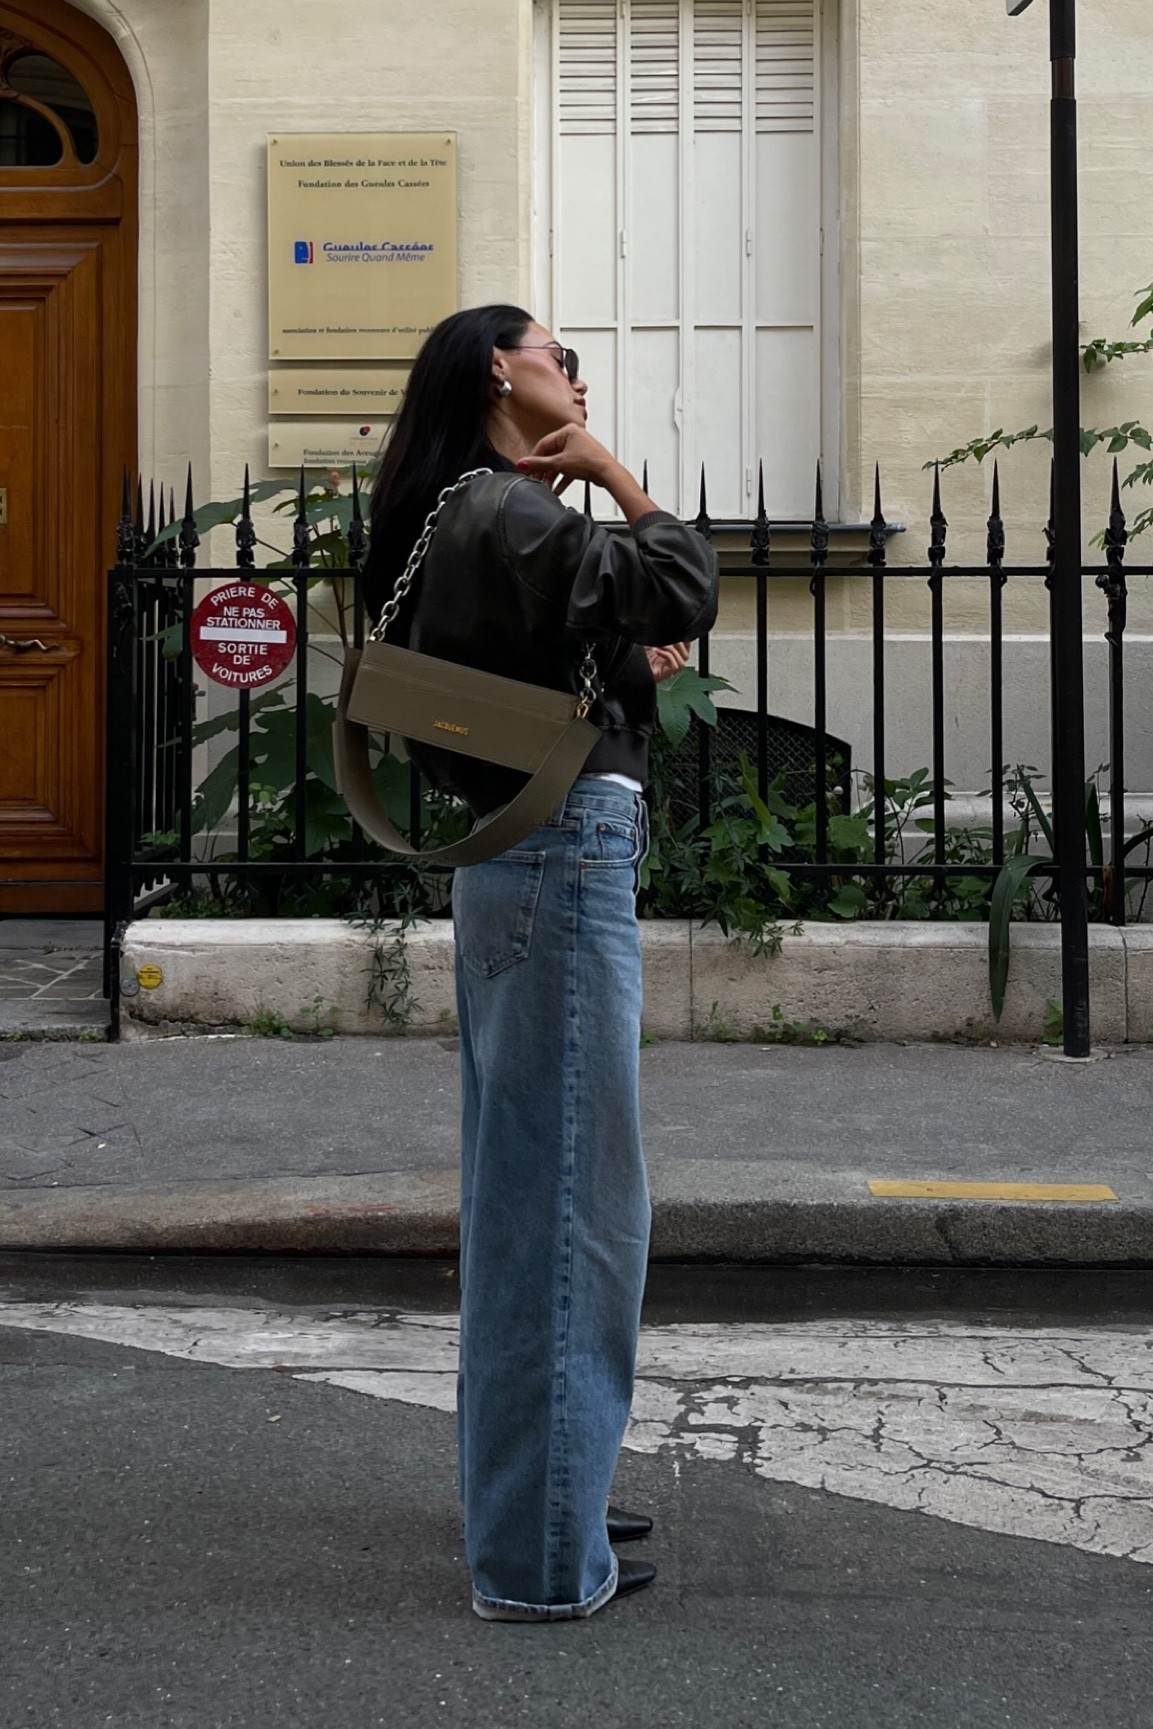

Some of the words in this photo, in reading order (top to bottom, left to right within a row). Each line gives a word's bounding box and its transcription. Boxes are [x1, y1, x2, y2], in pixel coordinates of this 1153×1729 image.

[279, 159, 305, 167] Union
[308, 159, 321, 167] des
[355, 159, 366, 167] de
[368, 159, 375, 167] la
[377, 159, 396, 167] Face
[408, 159, 418, 167] de
[420, 159, 428, 167] la
[298, 179, 342, 188] Fondation
[344, 179, 358, 188] des
[361, 179, 395, 188] Gueules
[398, 179, 430, 188] Cassées
[323, 241, 378, 251] Gueules
[326, 253, 360, 262] Sourire
[361, 253, 394, 263] Quand
[395, 252, 426, 262] Même
[298, 388, 338, 396] Fondation
[340, 388, 350, 396] du
[352, 388, 387, 396] Souvenir
[388, 388, 399, 396] de
[303, 448, 340, 456] Fondation
[341, 448, 354, 456] des
[210, 586, 256, 607] PRIERE
[261, 592, 279, 610] DE
[223, 606, 239, 617] NE
[243, 607, 265, 618] PAS
[206, 616, 281, 630] STATIONNER
[218, 643, 268, 655] SORTIE
[233, 654, 251, 665] DE
[212, 662, 273, 683] VOITURES
